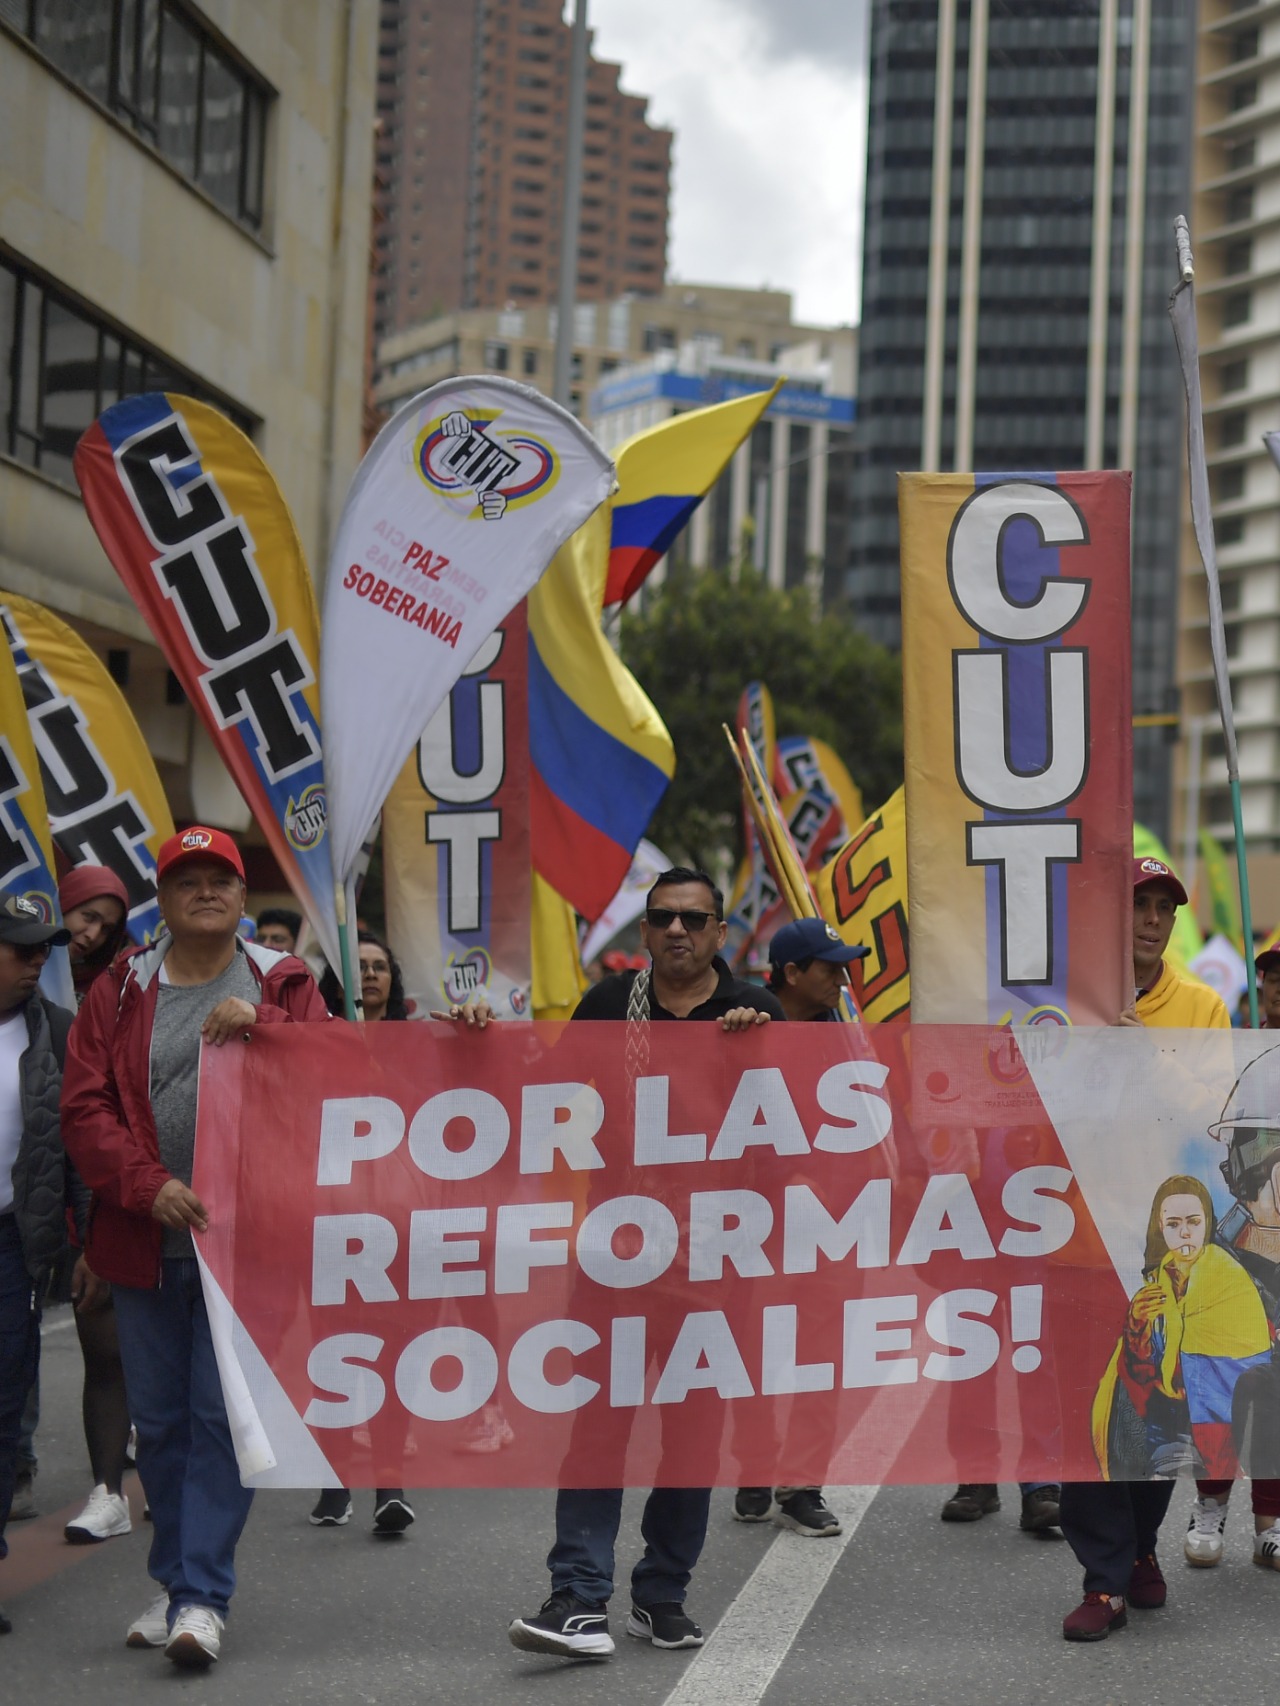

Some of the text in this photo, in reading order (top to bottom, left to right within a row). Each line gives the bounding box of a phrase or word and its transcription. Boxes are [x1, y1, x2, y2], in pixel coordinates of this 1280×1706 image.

[440, 427, 522, 494] CUT
[114, 411, 322, 786] CUT
[343, 564, 463, 650] SOBERANIA
[402, 541, 450, 583] PAZ
[946, 479, 1092, 987] CUT
[317, 1060, 893, 1187] POR LAS
[312, 1165, 1076, 1306] REFORMAS
[303, 1284, 1043, 1429] SOCIALES!
